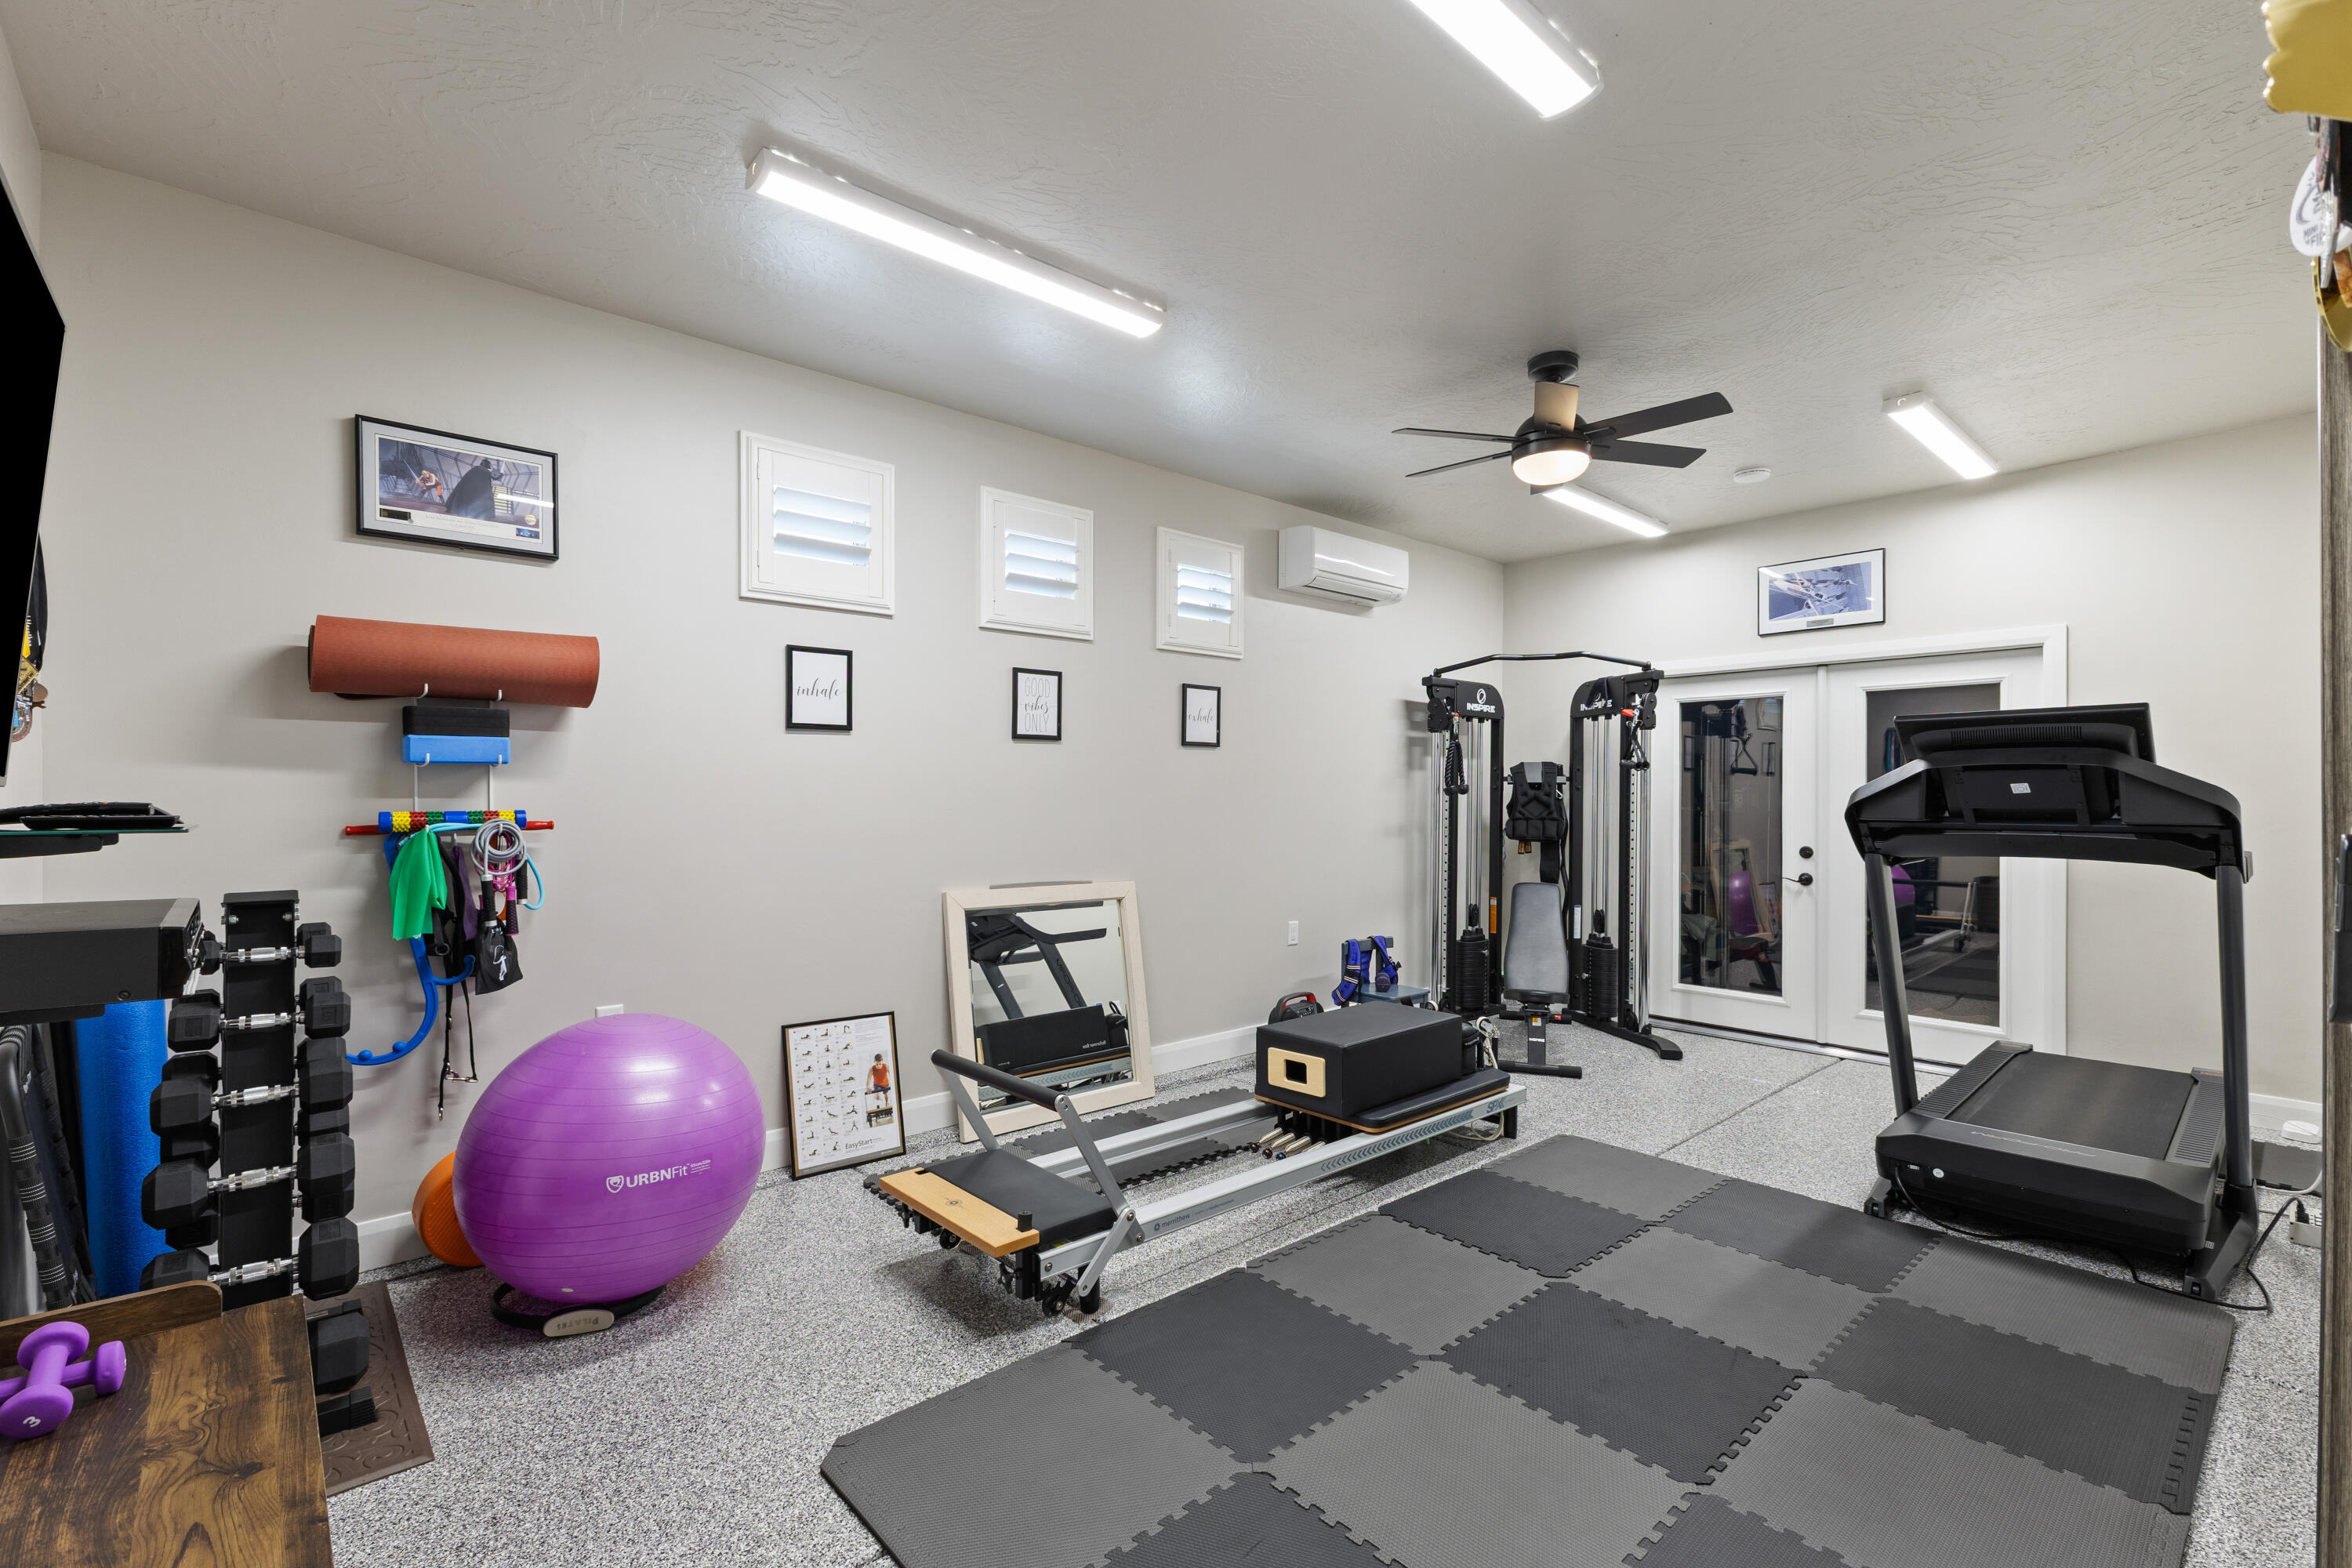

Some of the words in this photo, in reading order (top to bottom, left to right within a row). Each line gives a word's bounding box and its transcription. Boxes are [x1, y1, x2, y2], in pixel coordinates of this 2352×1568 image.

[797, 678, 840, 700] inhale
[1025, 677, 1050, 698] GOOD
[1025, 695, 1048, 714] vibes
[1467, 702, 1495, 713] INSPIRE
[1025, 713, 1049, 732] ONLY
[1189, 708, 1213, 724] exhale
[845, 1138, 873, 1150] EasyStart
[626, 1166, 688, 1188] URBNFit
[1161, 1214, 1191, 1228] merrithew
[23, 1416, 41, 1428] 3
